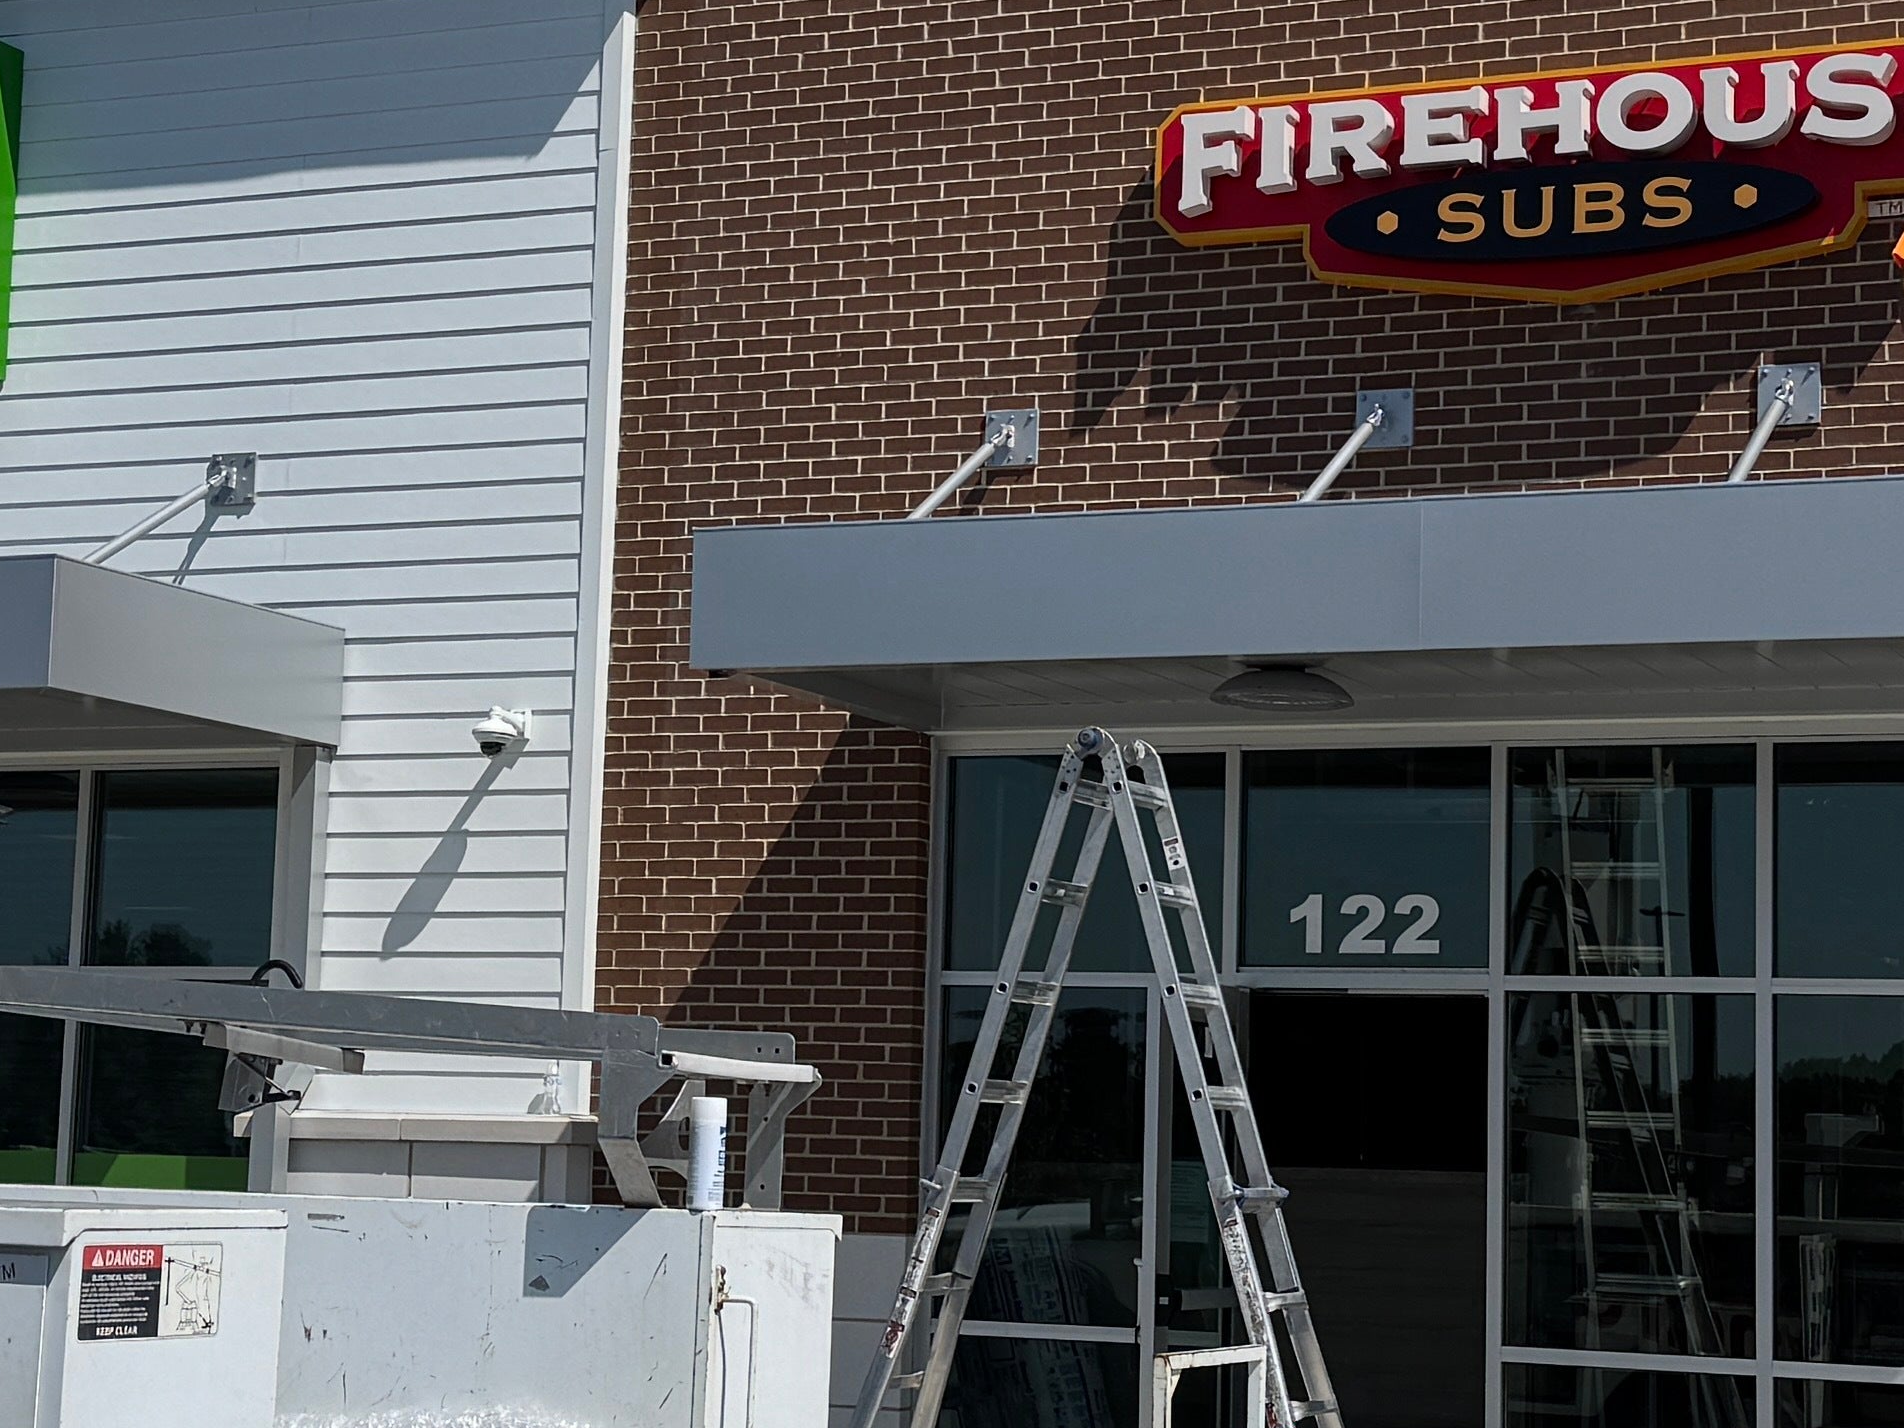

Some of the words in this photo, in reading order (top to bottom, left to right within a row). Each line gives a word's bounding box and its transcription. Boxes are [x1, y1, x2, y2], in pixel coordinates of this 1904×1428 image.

[1437, 176, 1694, 243] SUBS
[1289, 893, 1440, 954] 122
[105, 1249, 155, 1267] DANGER
